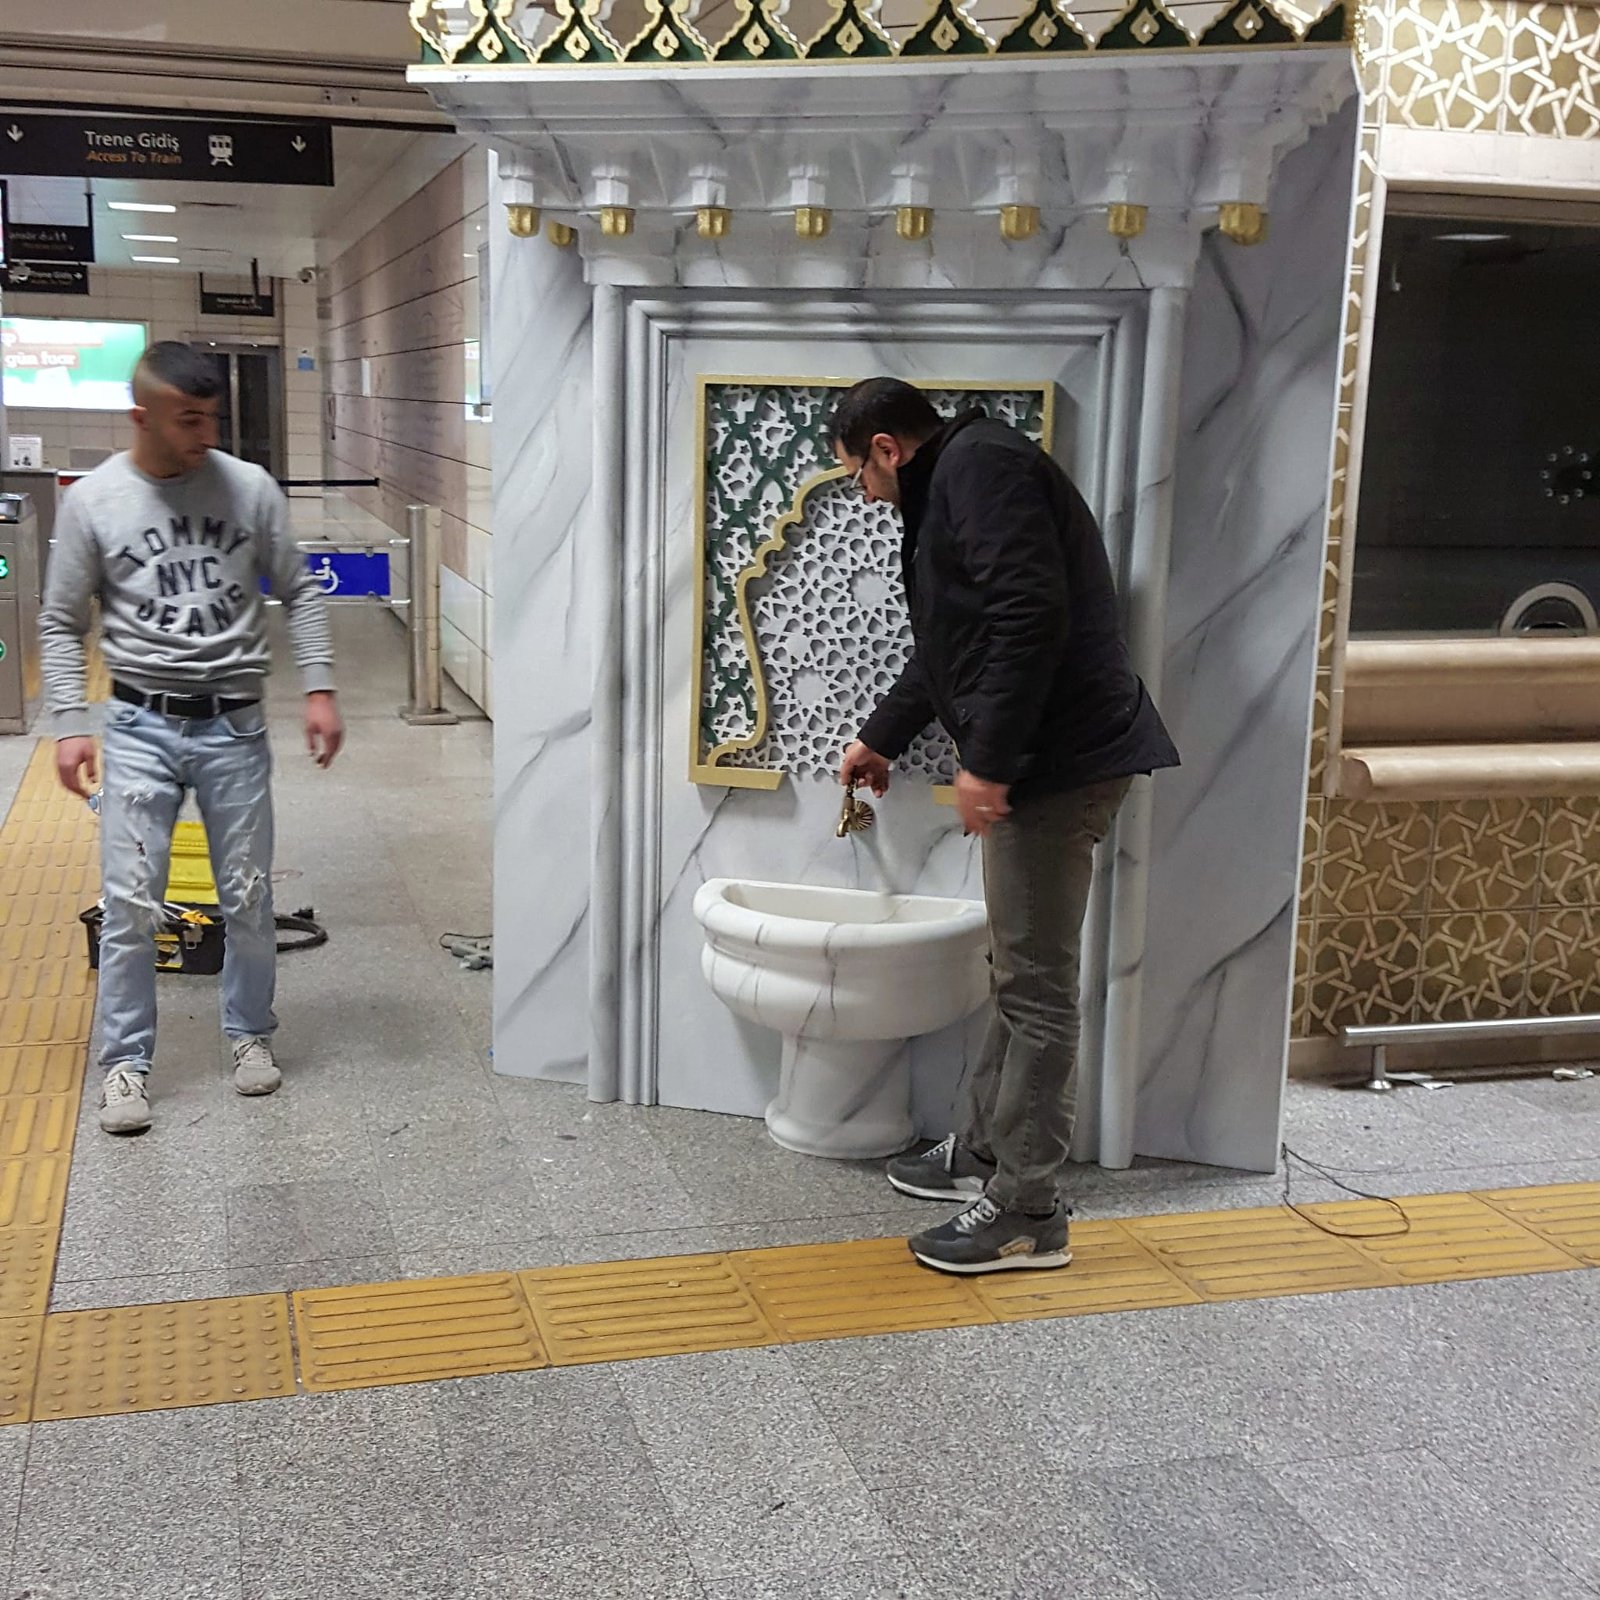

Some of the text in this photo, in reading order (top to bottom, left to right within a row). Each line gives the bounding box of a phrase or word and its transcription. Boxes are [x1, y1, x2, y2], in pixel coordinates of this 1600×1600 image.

[84, 130, 180, 152] Trene Gidiş
[86, 150, 182, 164] Access To Train
[117, 515, 250, 567] TOMMY
[156, 555, 223, 597] NYC
[136, 583, 244, 637] JEANS
